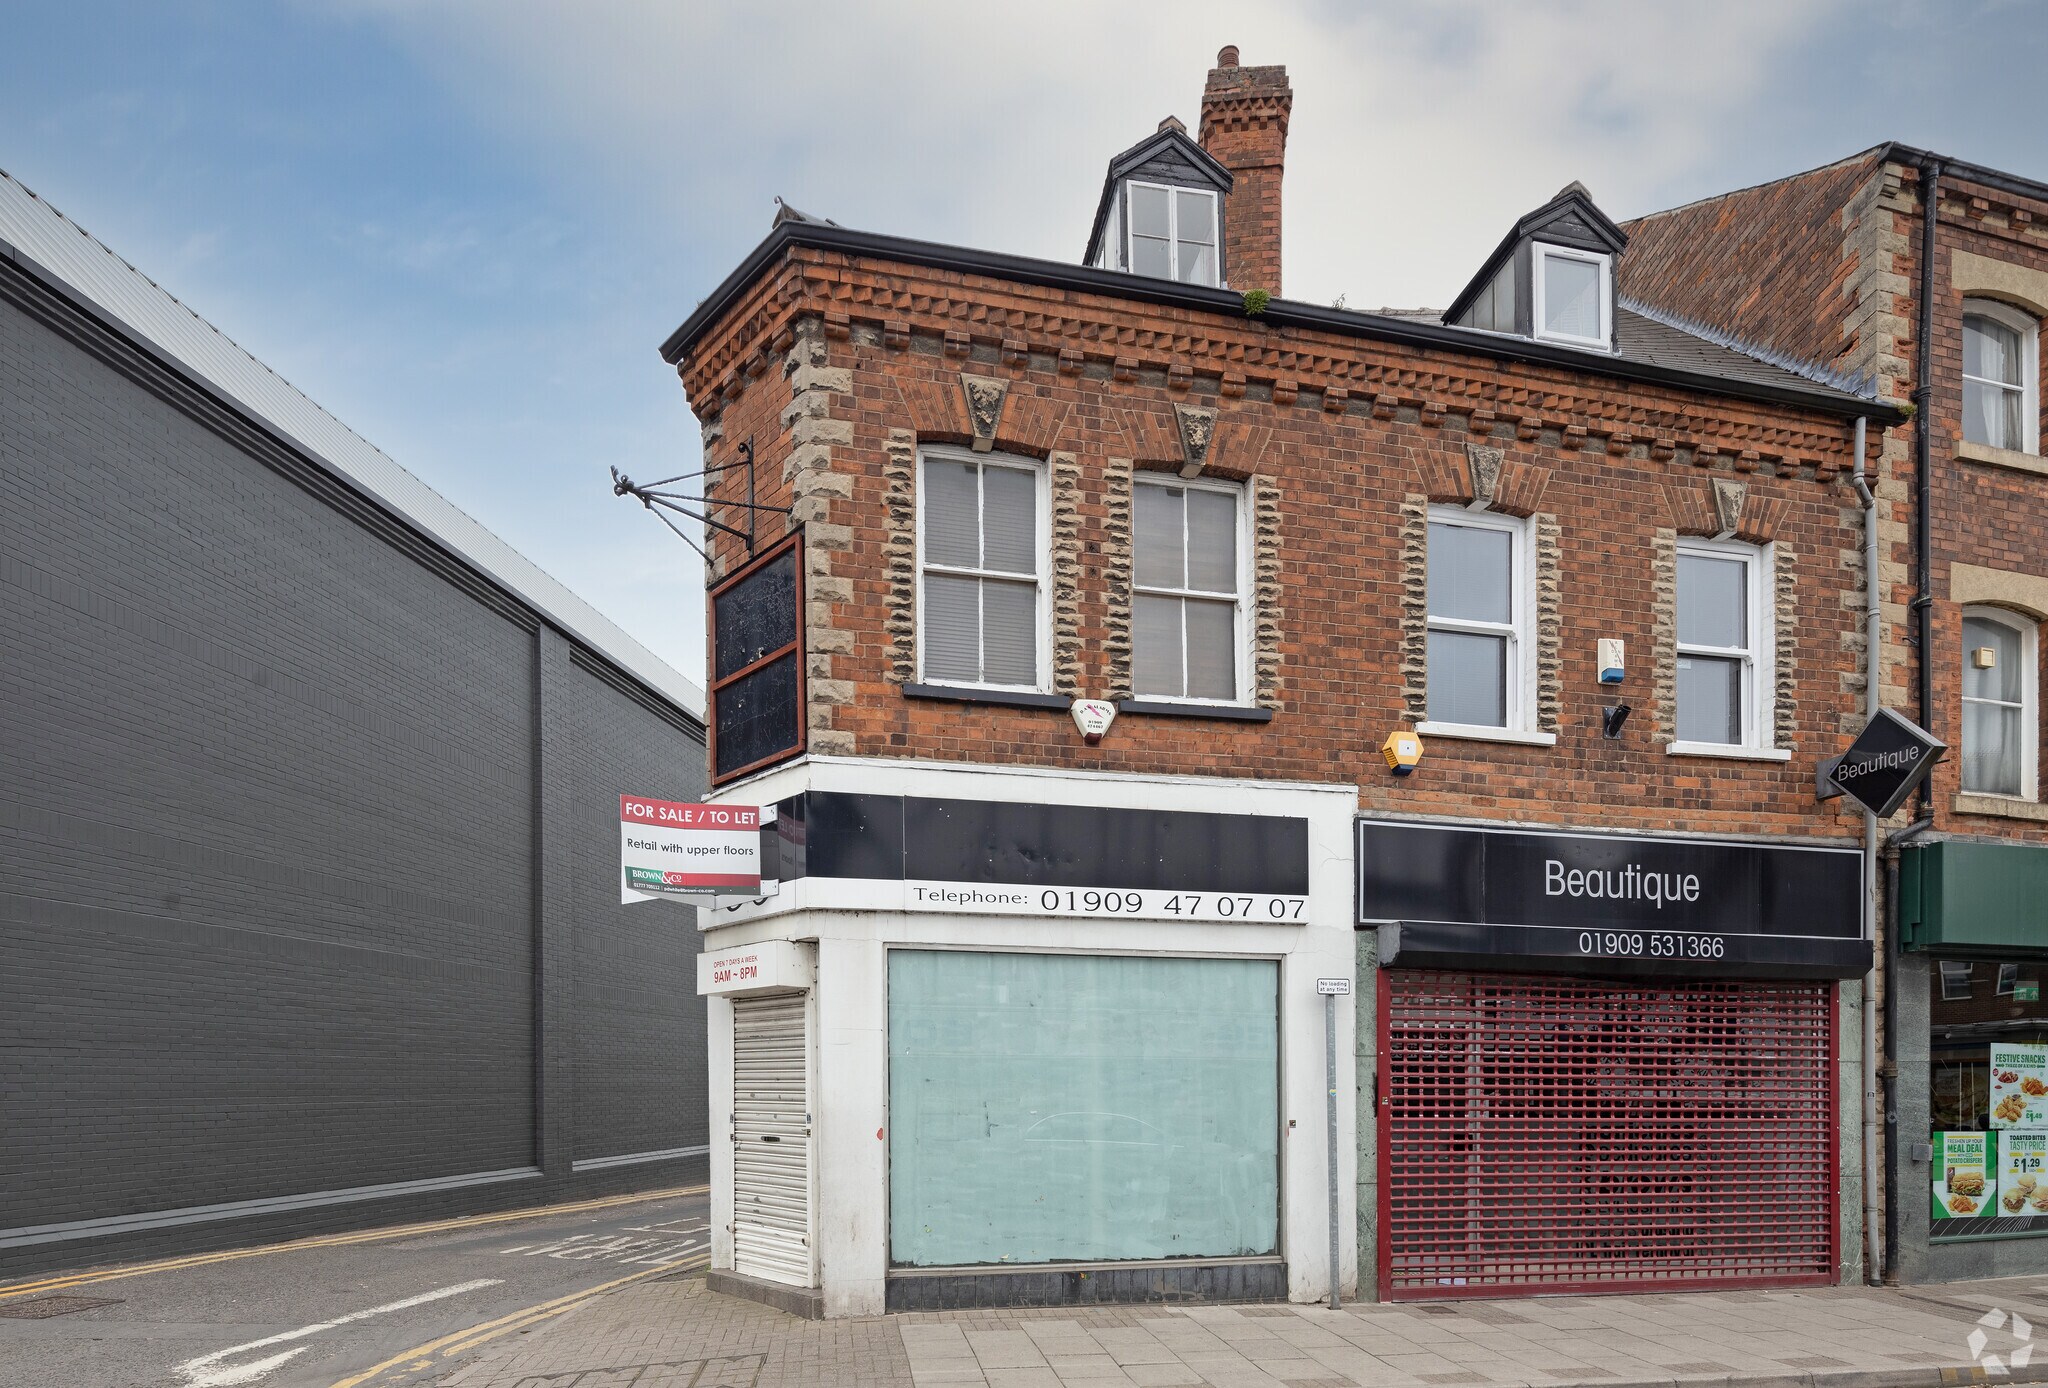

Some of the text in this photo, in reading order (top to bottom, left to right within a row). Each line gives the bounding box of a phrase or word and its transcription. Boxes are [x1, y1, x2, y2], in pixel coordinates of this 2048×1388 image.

[1838, 745, 1919, 781] Beautique
[625, 803, 654, 818] FOR
[659, 807, 692, 822] SALE
[710, 811, 729, 822] TO
[735, 812, 755, 824] LET
[627, 838, 754, 856] Retail with upper floors
[1545, 859, 1700, 909] Beautique
[913, 887, 1305, 919] Telephone: 01909 47 07 07
[1579, 932, 1725, 958] 01909 531366
[713, 961, 725, 969] OPEN
[729, 958, 740, 966] DAYS
[745, 955, 758, 963] WEEK
[714, 969, 731, 984] 9AM
[740, 965, 757, 980] 8PM
[1995, 1054, 2046, 1064] FESTIVE SNACKS
[1947, 1144, 1983, 1153] MEAL DEAL
[2010, 1141, 2046, 1150] TASTY PRICE
[2013, 1158, 2041, 1173] £1.29
